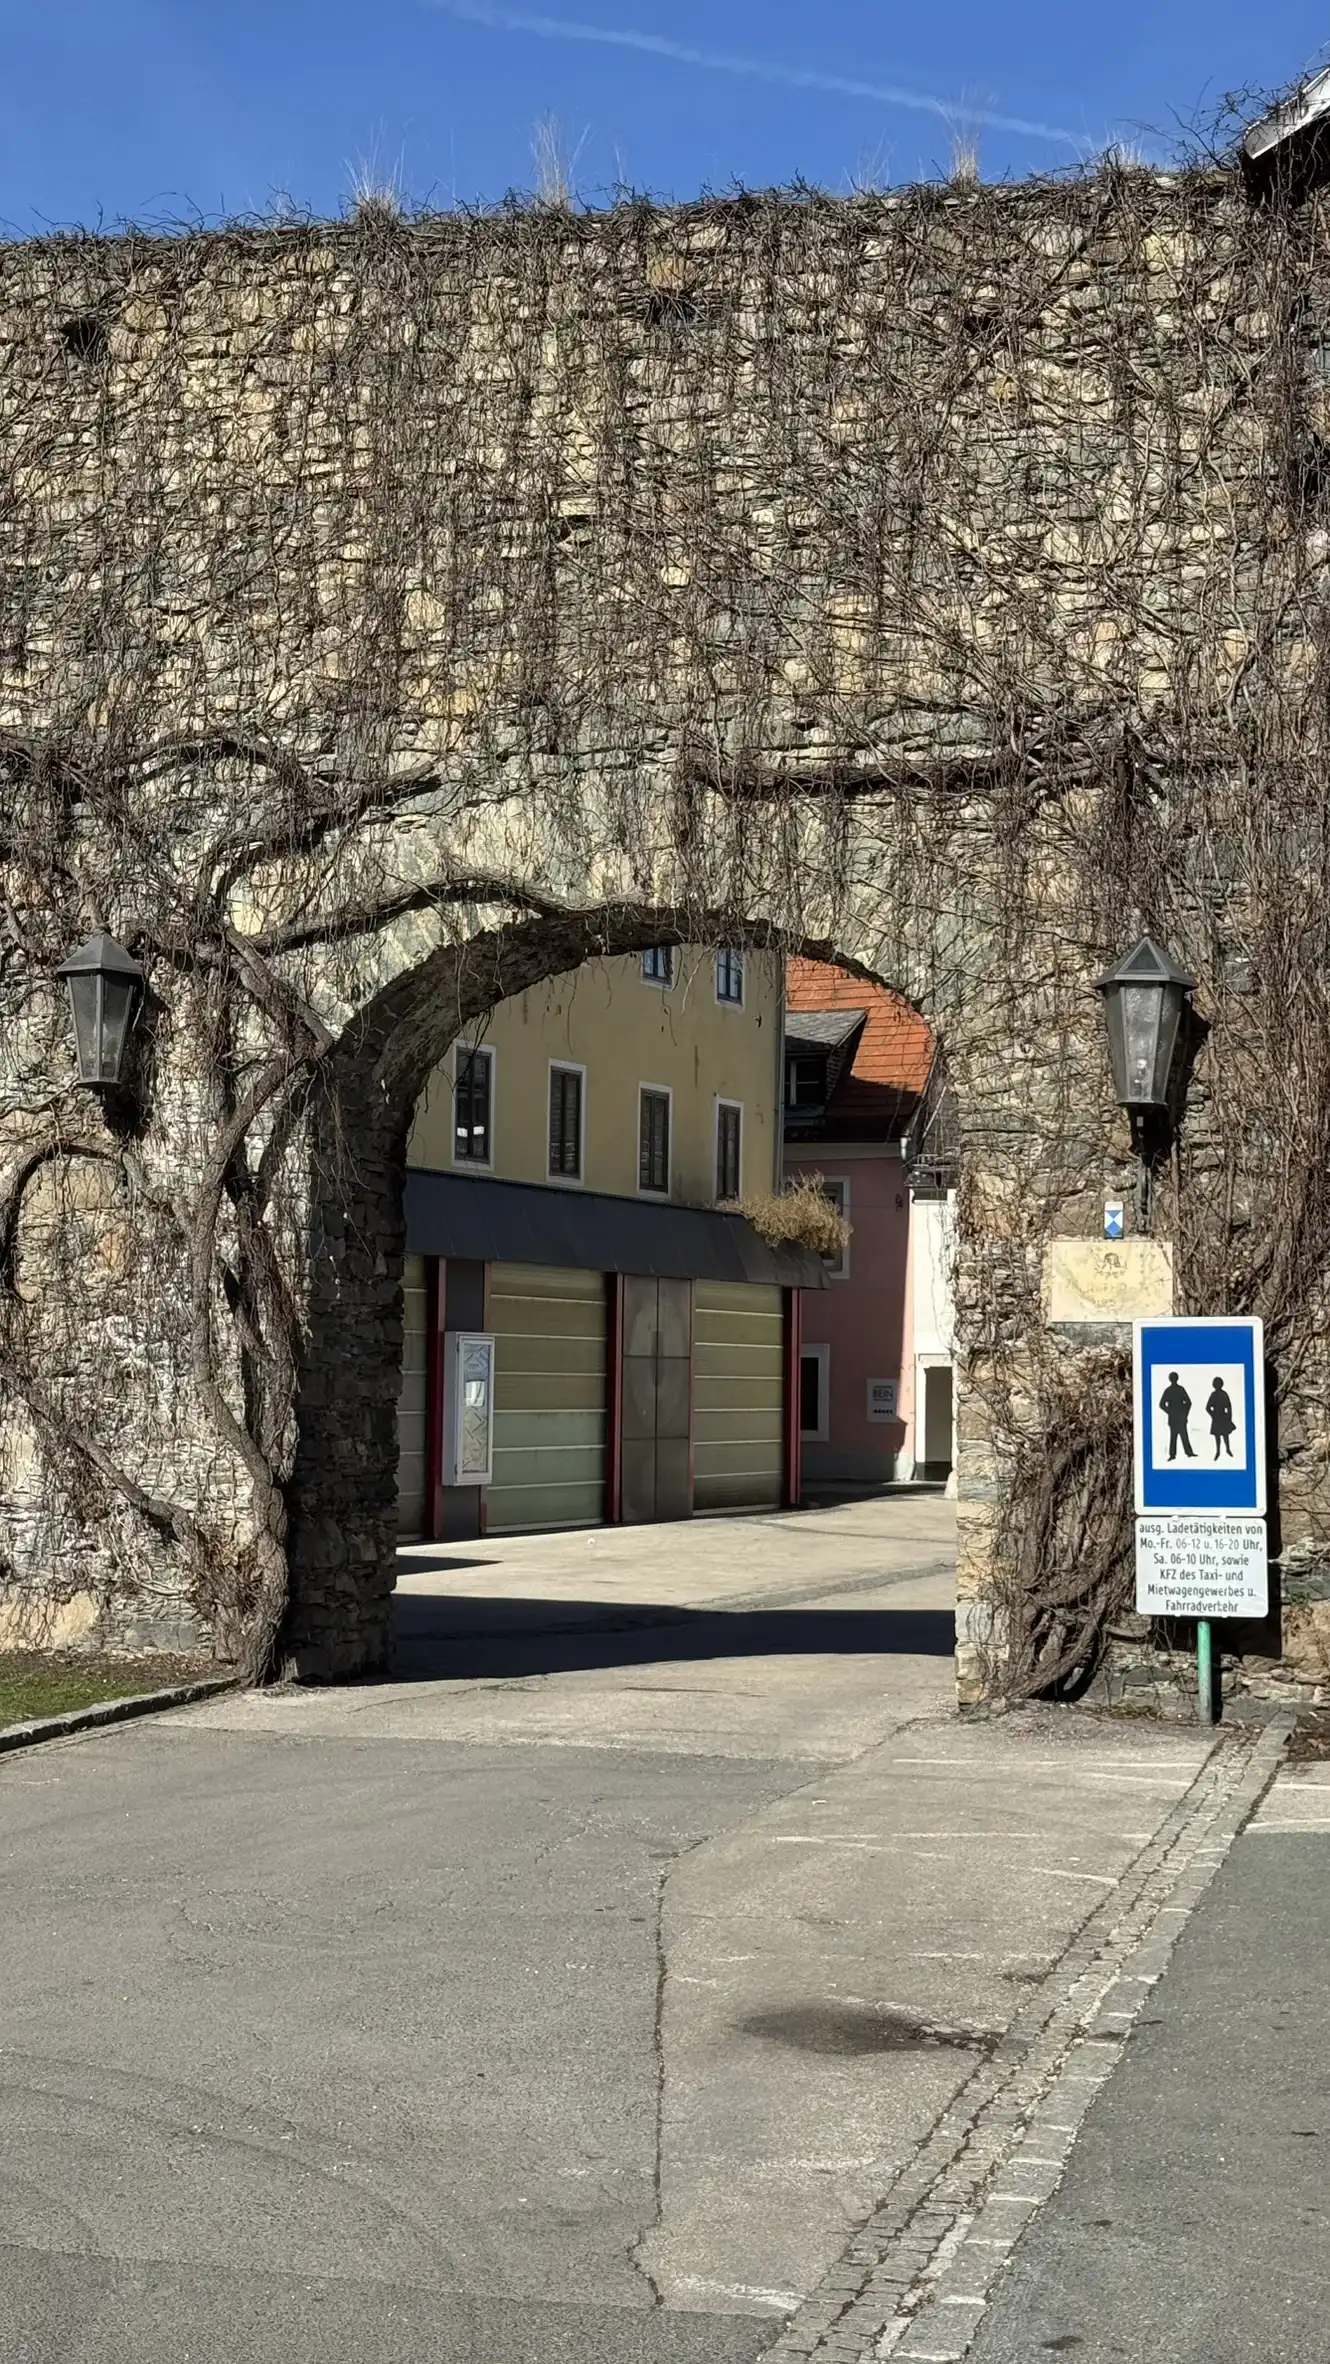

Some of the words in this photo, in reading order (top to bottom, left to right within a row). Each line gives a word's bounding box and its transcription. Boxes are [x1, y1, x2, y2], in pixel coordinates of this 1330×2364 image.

[1140, 1524, 1164, 1535] ausg.
[1167, 1522, 1242, 1536] Ladetätigkeiten
[1245, 1526, 1262, 1534] von
[1140, 1538, 1172, 1549] Mo.-Fr.
[1176, 1539, 1200, 1549] 06-12
[1216, 1539, 1239, 1549] 16-20
[1243, 1540, 1262, 1552] Uhr,
[1154, 1553, 1167, 1564] Sa.
[1171, 1554, 1196, 1564] 06-10
[1199, 1554, 1219, 1566] Uhr,
[1222, 1555, 1249, 1565] sowie
[1160, 1569, 1176, 1579] KFZ
[1180, 1569, 1196, 1580] des
[1199, 1569, 1222, 1580] Taxi-
[1226, 1570, 1243, 1581] und
[1148, 1584, 1244, 1598] Mietwagengewerbes
[1248, 1589, 1256, 1597] u.
[1166, 1600, 1238, 1612] Fahrradverkehr
